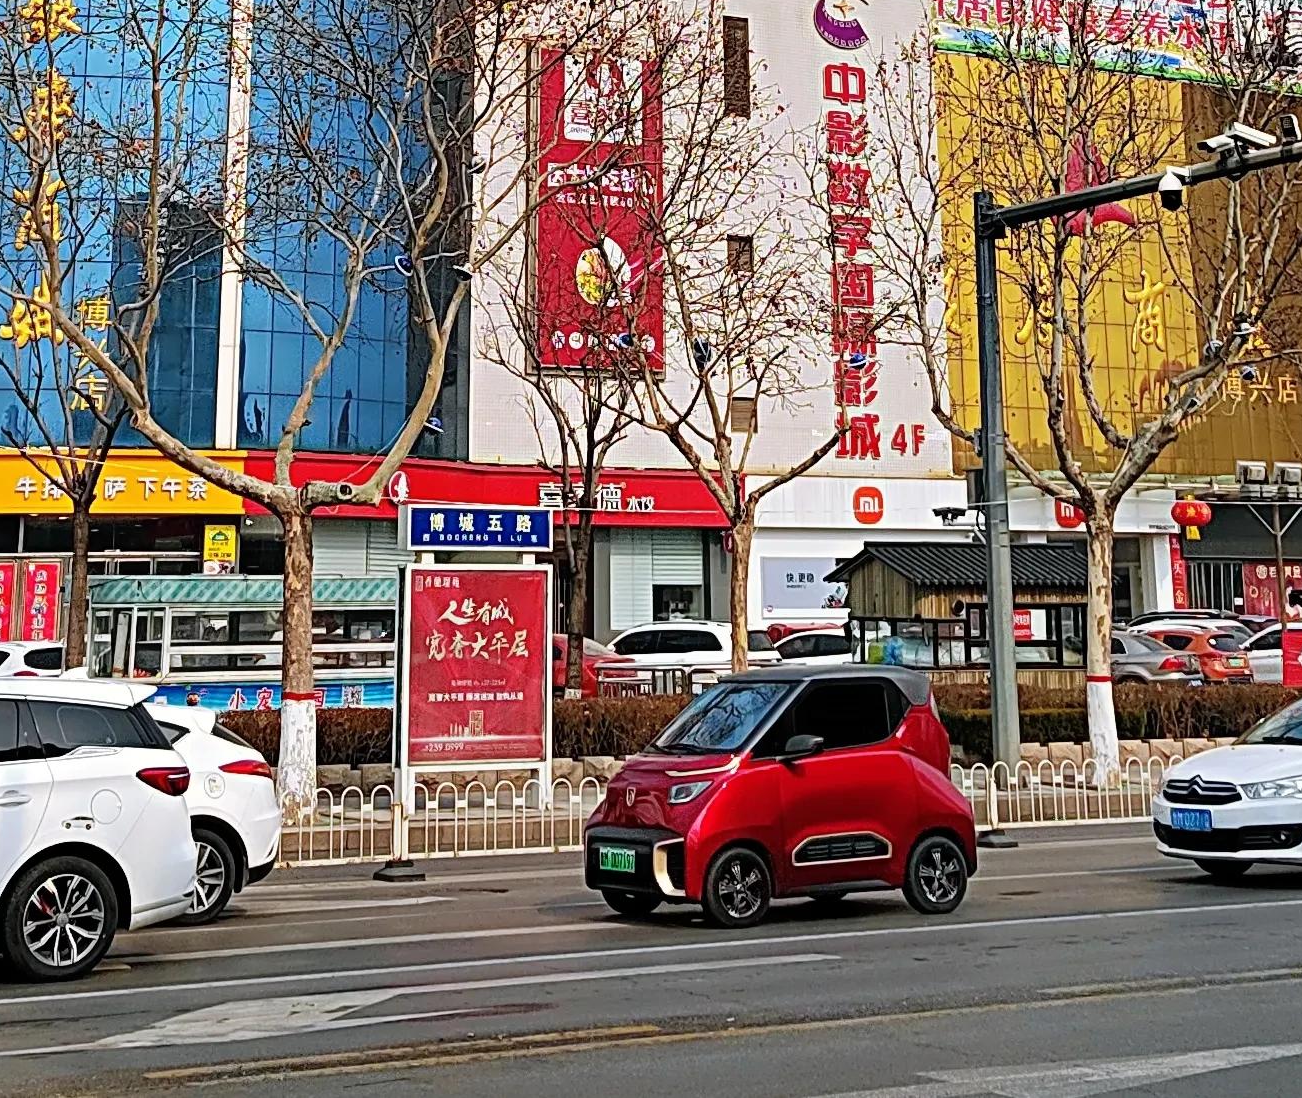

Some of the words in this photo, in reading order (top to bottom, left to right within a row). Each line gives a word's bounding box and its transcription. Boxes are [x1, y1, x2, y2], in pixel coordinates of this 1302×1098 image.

[890, 423, 926, 456] 4F
[430, 512, 532, 533] 博城五路
